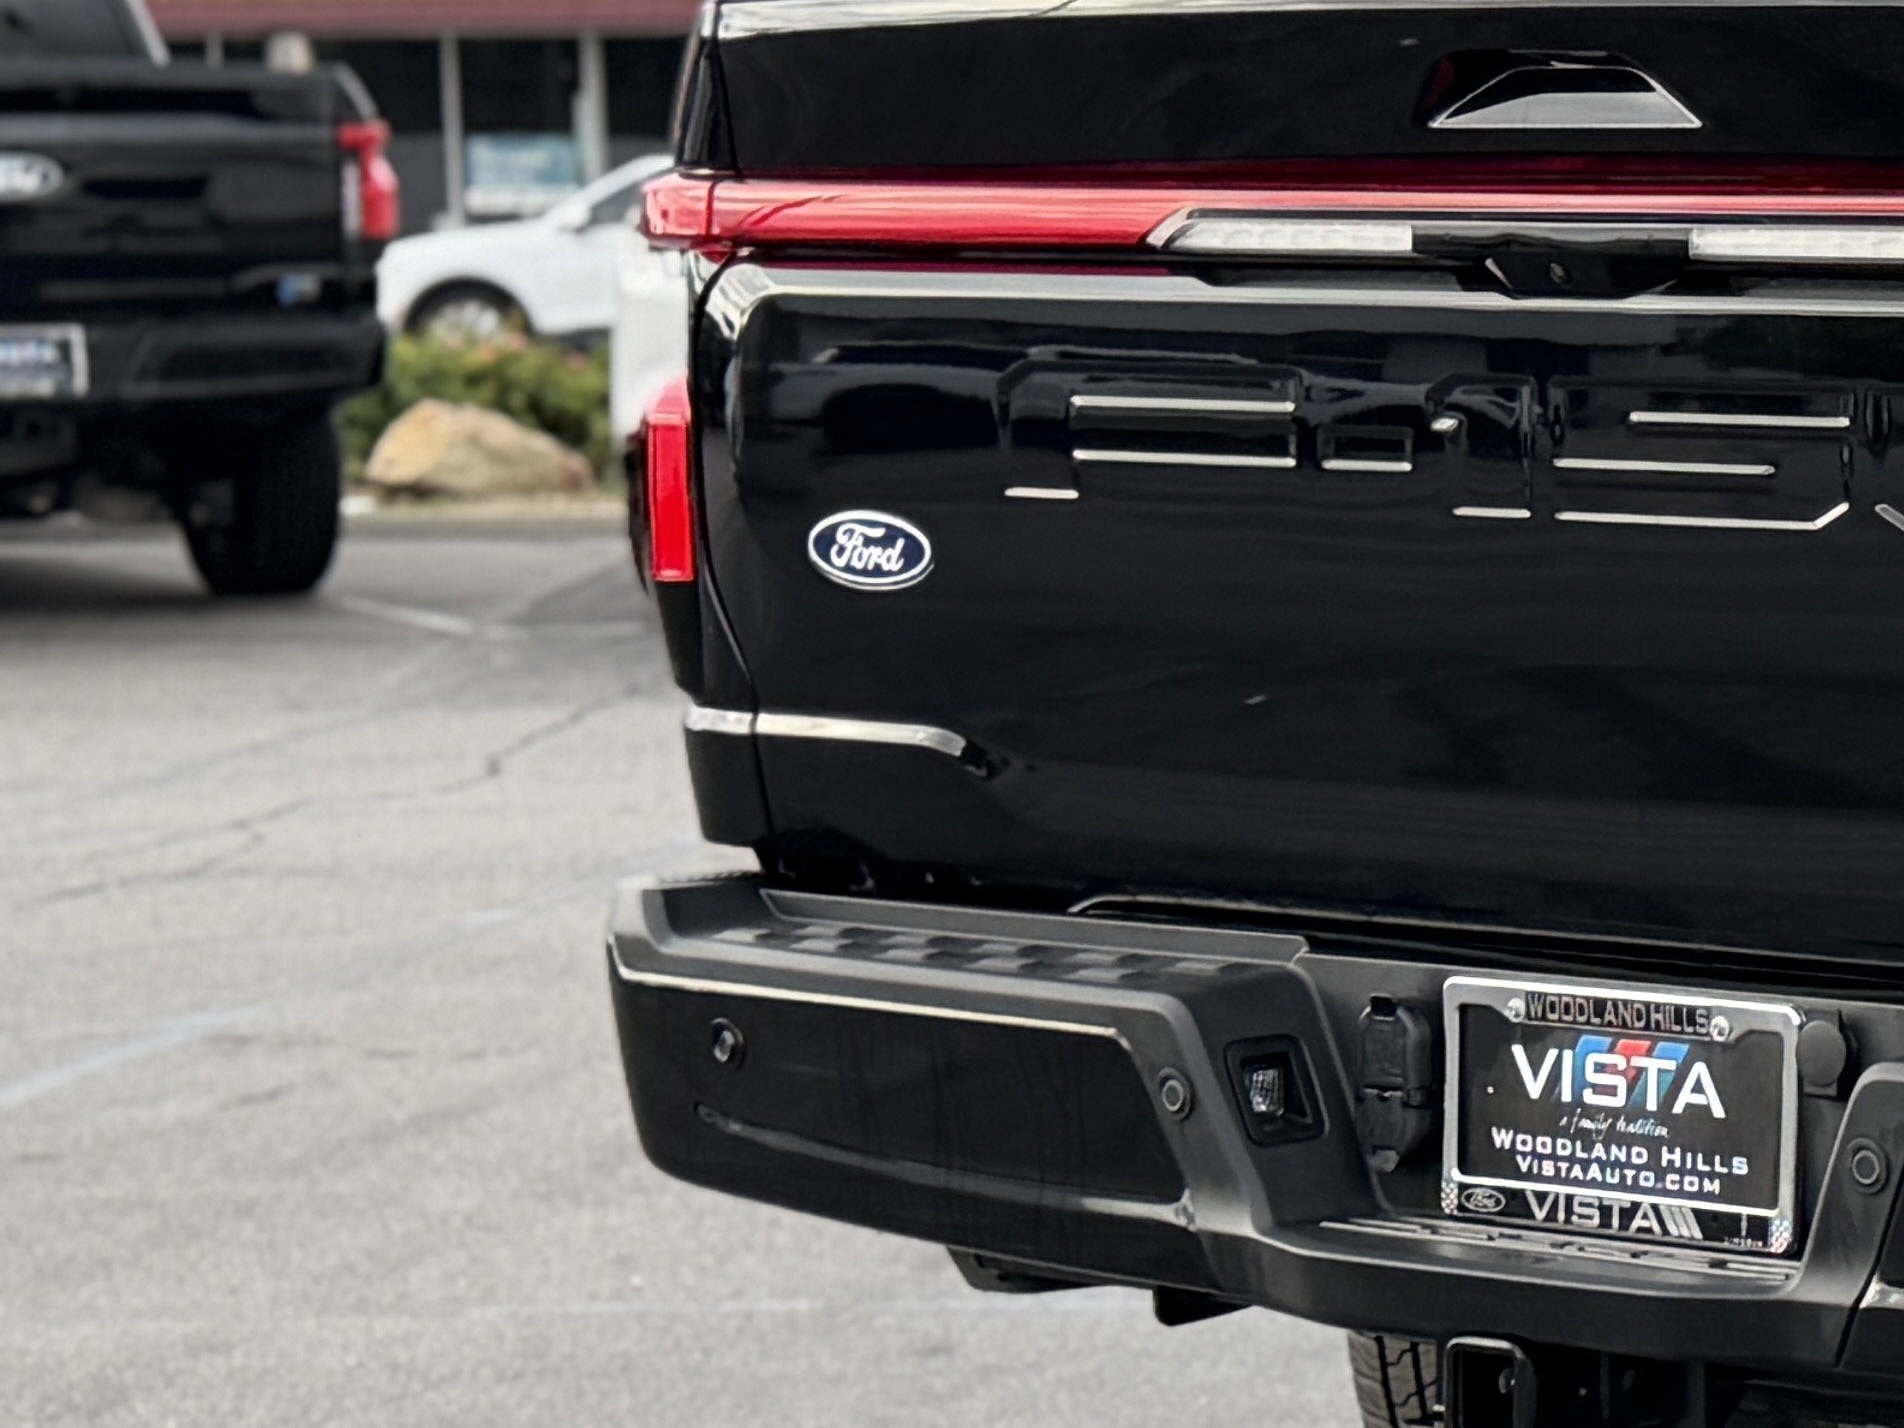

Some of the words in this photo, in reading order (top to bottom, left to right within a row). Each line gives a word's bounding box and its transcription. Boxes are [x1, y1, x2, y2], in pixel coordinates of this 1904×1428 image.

[830, 523, 905, 572] Ford
[1528, 993, 1646, 1028] WOODLAND
[1650, 1004, 1709, 1035] HILLS
[1511, 1043, 1726, 1118] VISTA
[1524, 1189, 1663, 1236] VISTA
